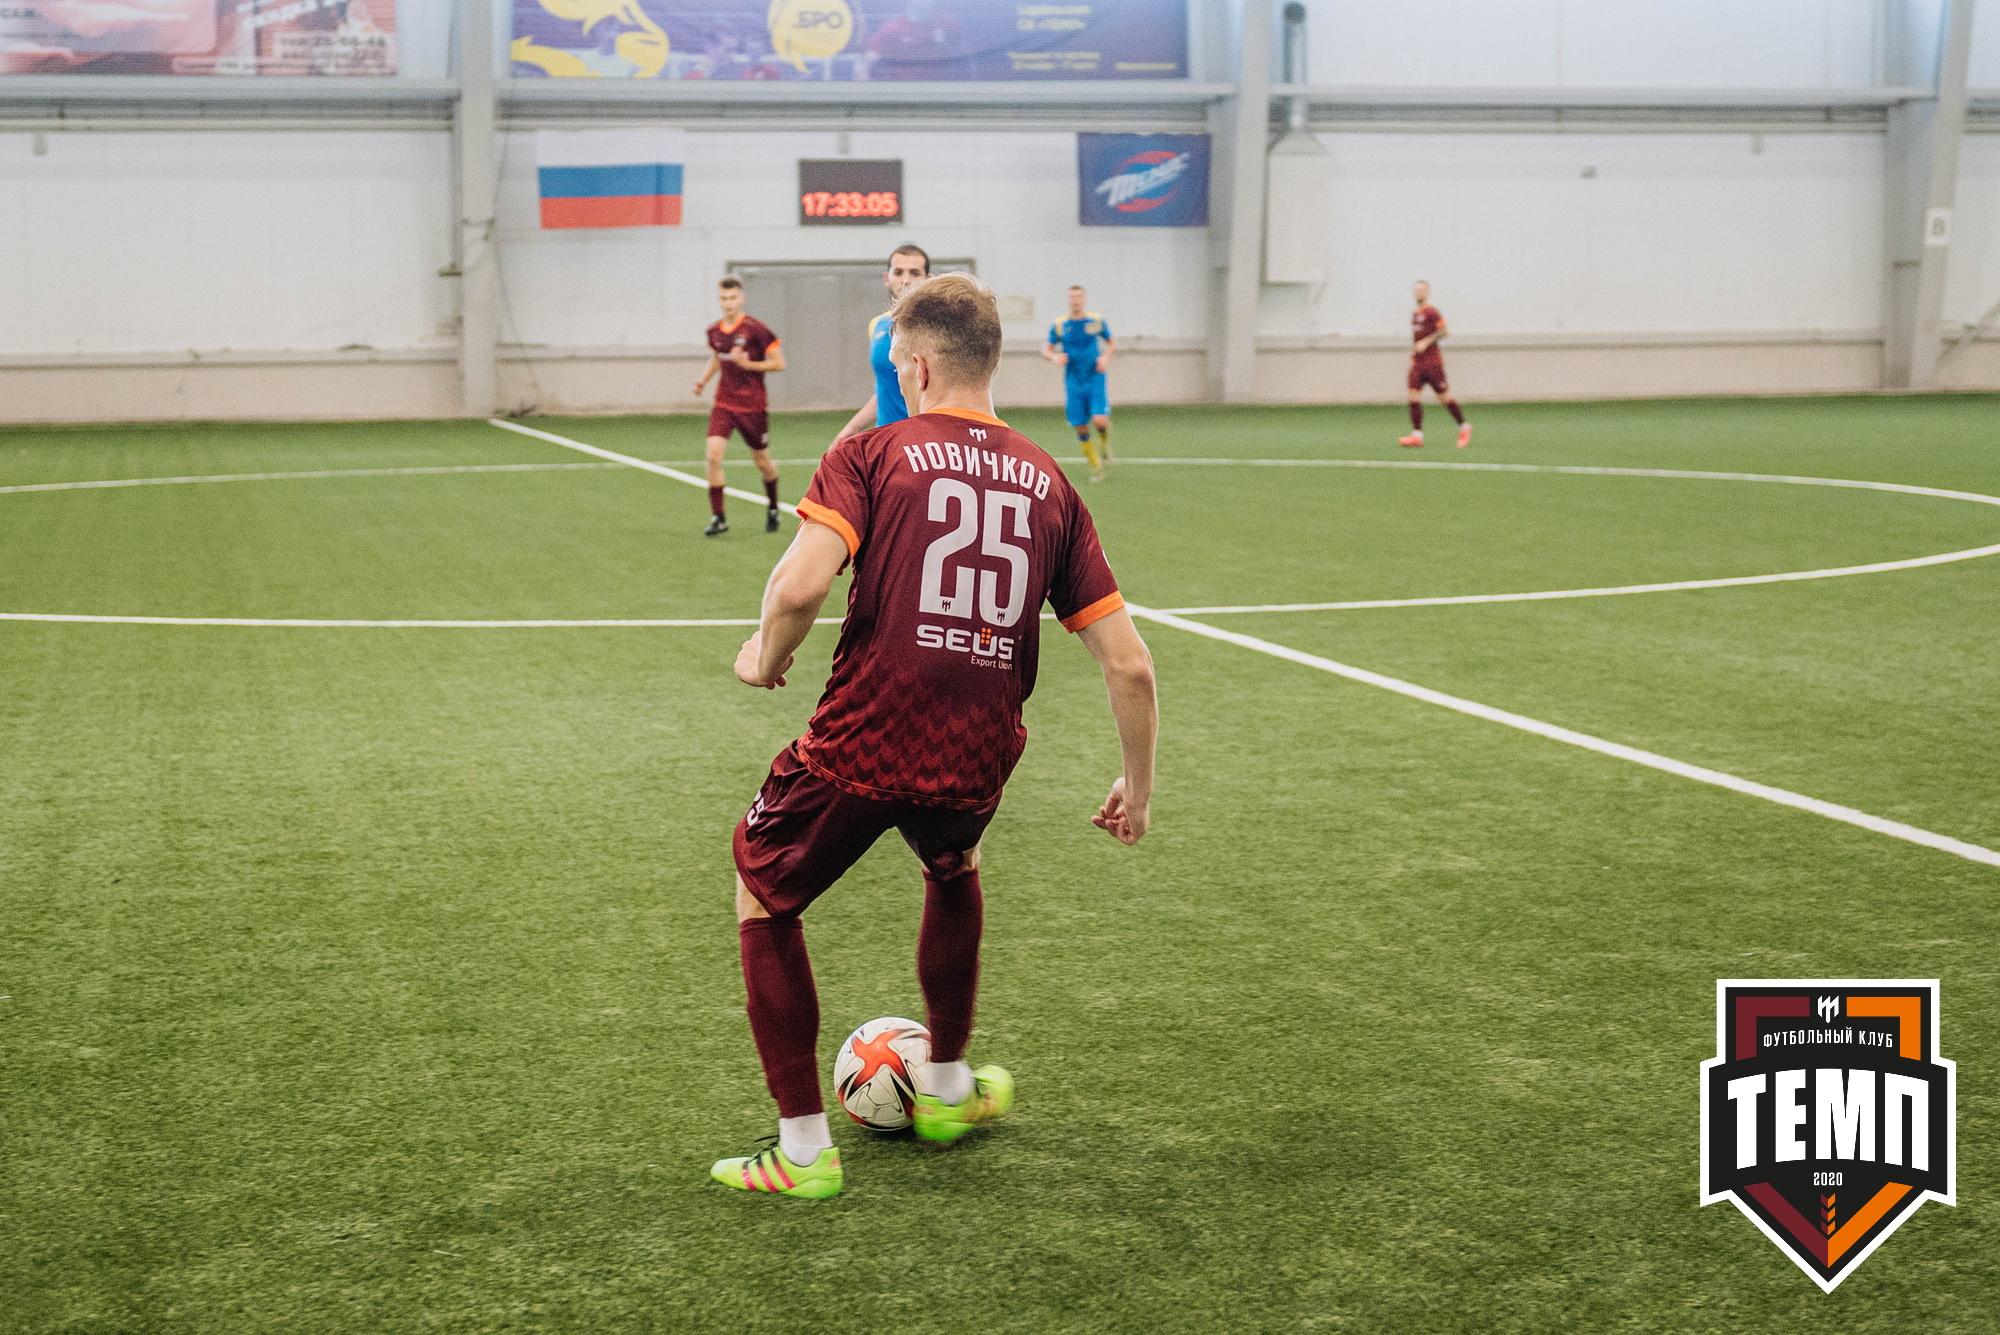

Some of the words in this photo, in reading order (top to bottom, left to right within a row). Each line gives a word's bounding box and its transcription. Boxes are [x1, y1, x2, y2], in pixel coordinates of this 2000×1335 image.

[802, 191, 898, 217] 17:33:05
[903, 442, 1051, 501] НОВИЧКОВ
[919, 477, 1032, 628] 25
[970, 655, 997, 668] Export
